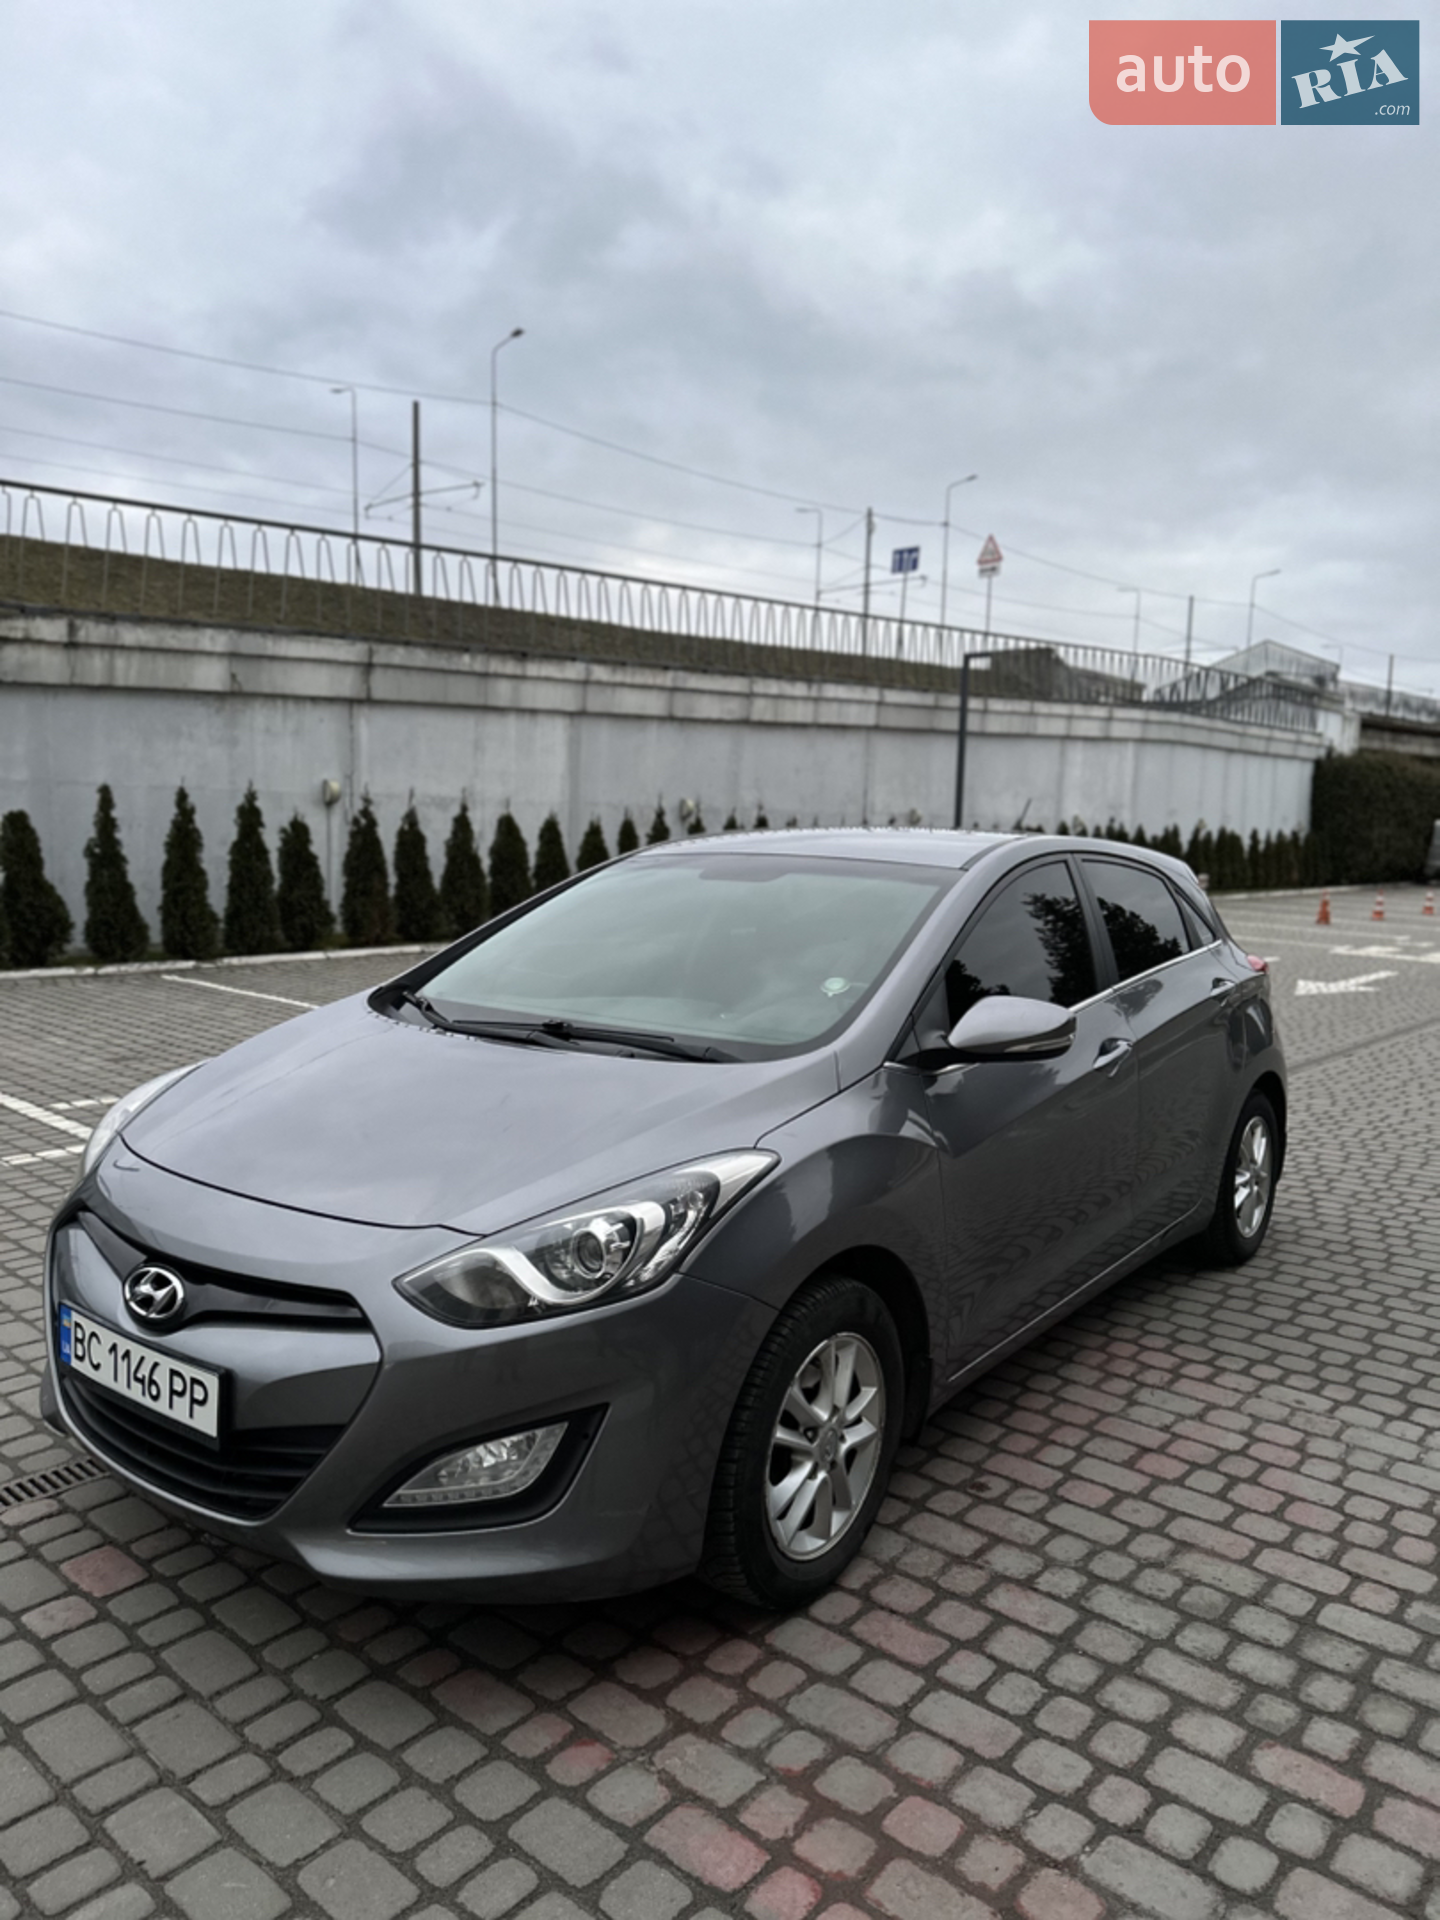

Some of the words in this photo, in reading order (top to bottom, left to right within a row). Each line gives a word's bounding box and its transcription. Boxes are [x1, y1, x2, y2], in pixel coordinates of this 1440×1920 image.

[73, 1320, 102, 1371] BC
[108, 1341, 161, 1402] 1146
[168, 1367, 209, 1419] PP
